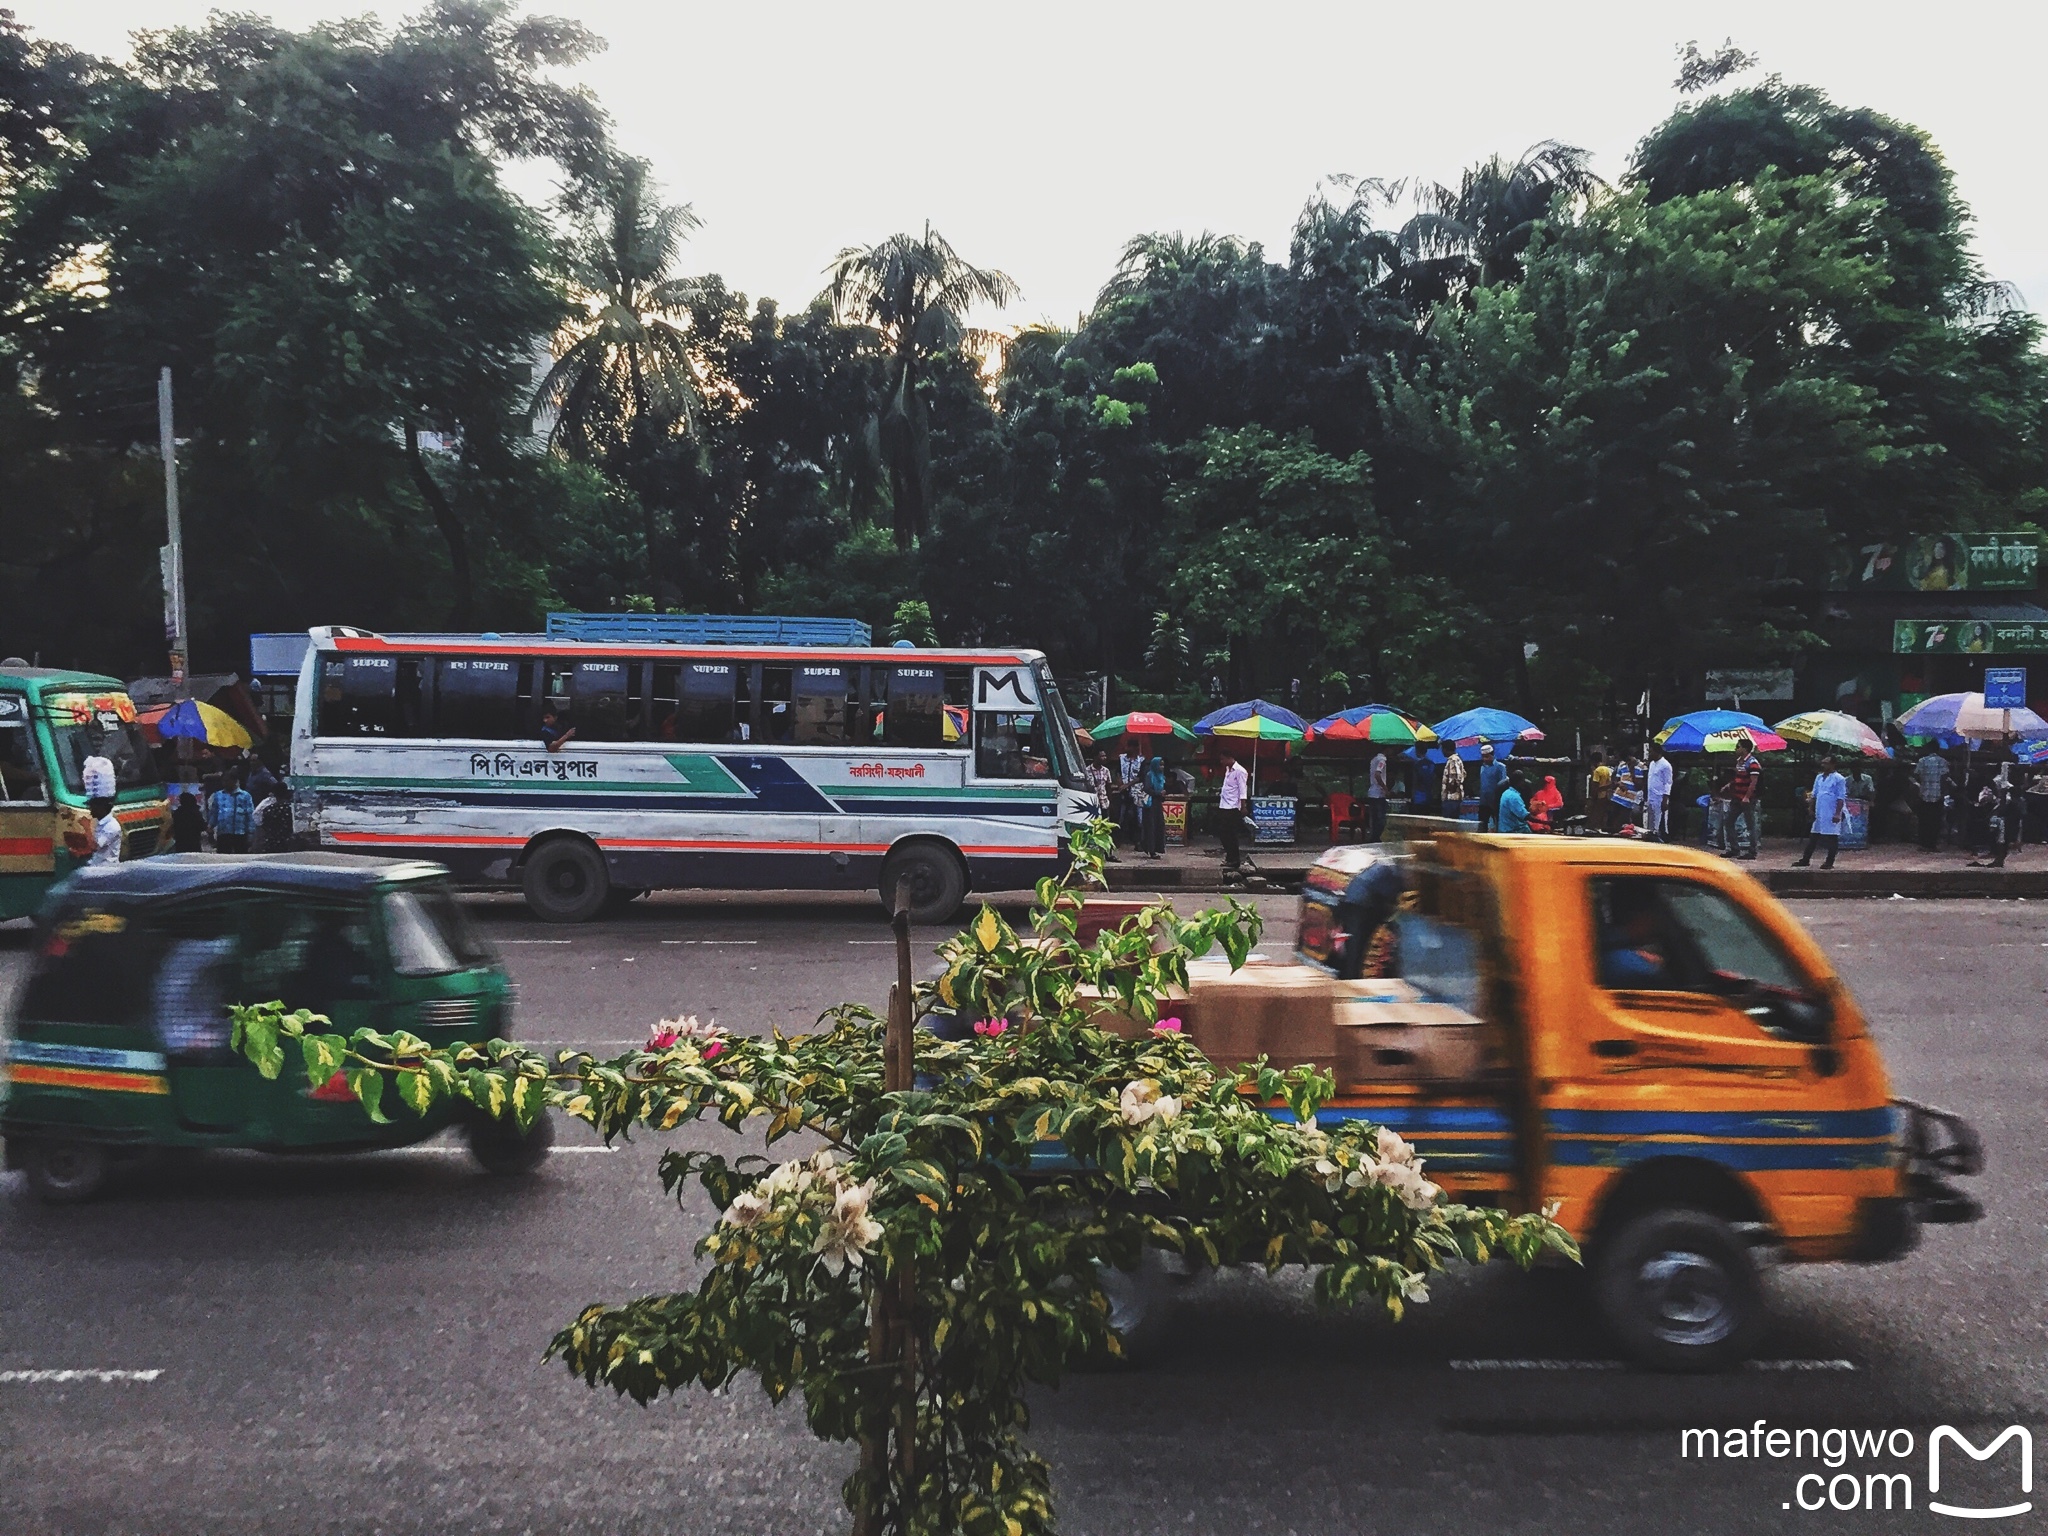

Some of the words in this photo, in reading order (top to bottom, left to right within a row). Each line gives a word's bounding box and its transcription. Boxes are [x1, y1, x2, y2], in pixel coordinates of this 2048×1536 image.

[352, 658, 389, 667] SUPER
[472, 661, 509, 670] SUPER
[582, 662, 620, 672] SUPER
[692, 665, 729, 674] SUPER
[803, 667, 840, 676] SUPER
[897, 668, 934, 677] SUPER
[552, 760, 598, 780] সুপার
